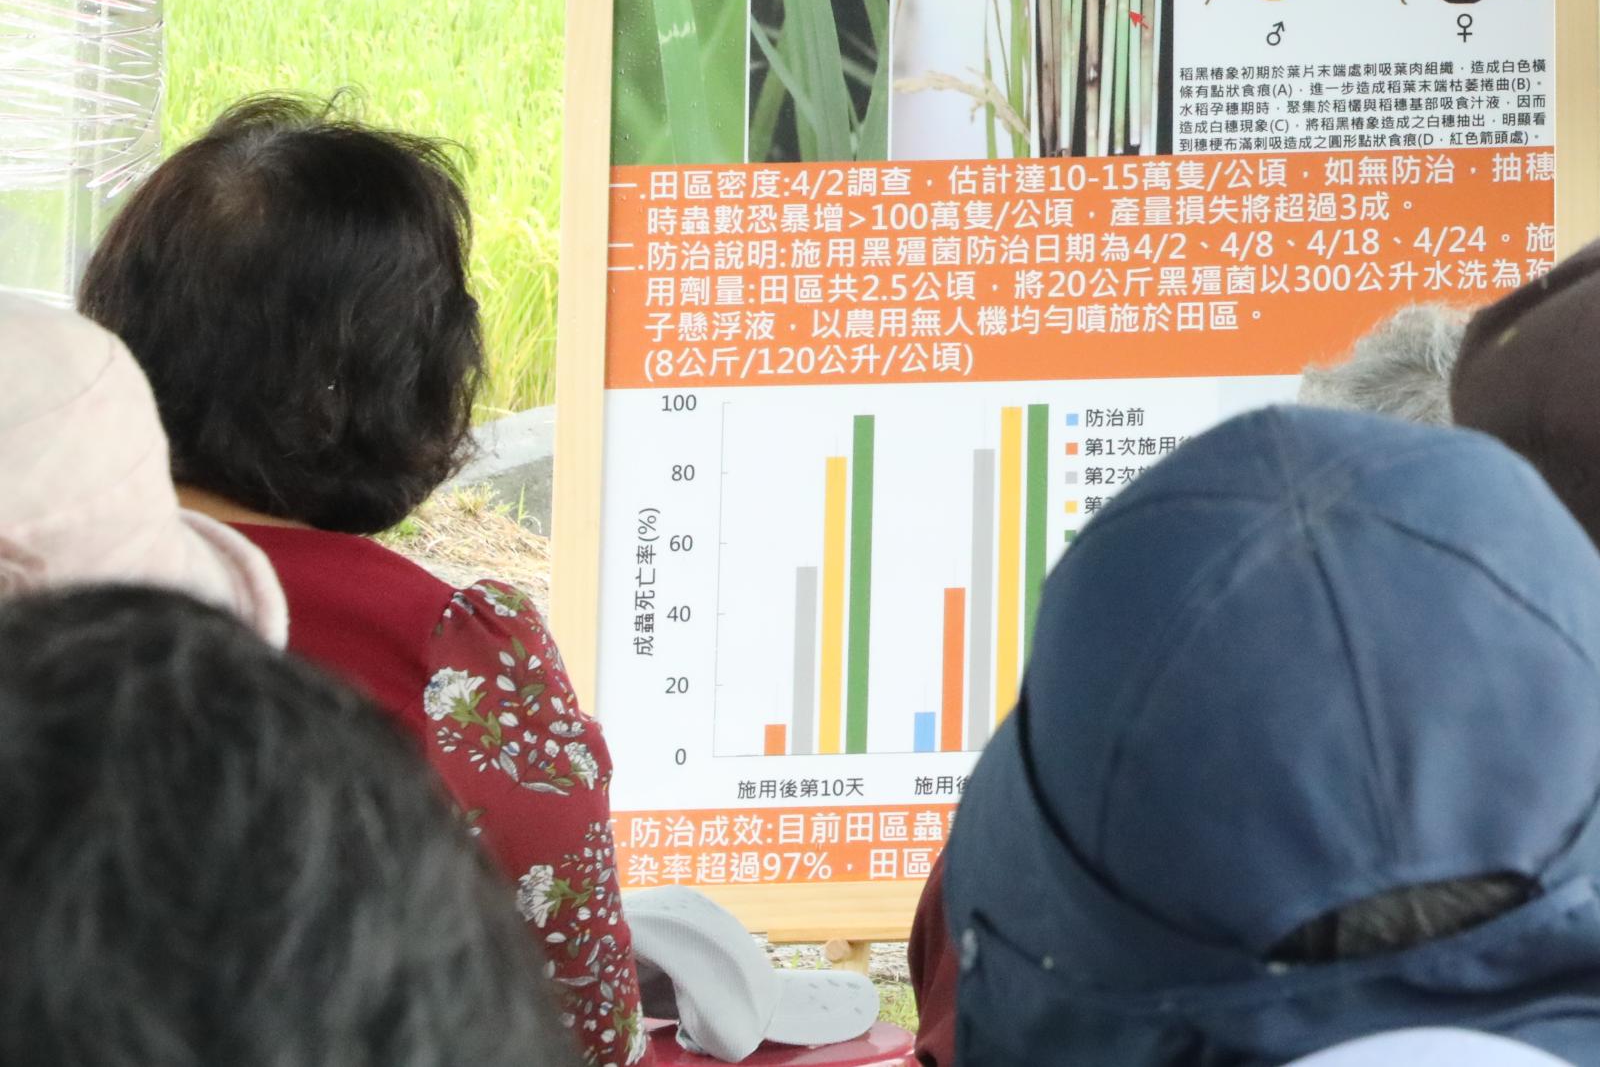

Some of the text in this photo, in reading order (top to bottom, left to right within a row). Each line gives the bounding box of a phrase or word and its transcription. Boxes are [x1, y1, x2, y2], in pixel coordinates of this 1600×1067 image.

[644, 342, 975, 382] (8公斤/120公升/公頃)
[661, 395, 698, 412] 100
[1085, 408, 1145, 428] 防治前
[1085, 436, 1191, 457] 第1次施用
[671, 466, 695, 482] 80
[1085, 466, 1147, 485] 第2次
[1084, 496, 1116, 515] 第
[669, 535, 694, 552] 60
[633, 507, 660, 657] 成蟲死亡率(%)
[667, 606, 691, 622] 40
[665, 678, 689, 694] 20
[675, 749, 687, 765] 0
[737, 778, 865, 800] 施用後第10天
[627, 847, 946, 885] 染率超過97%，田區
